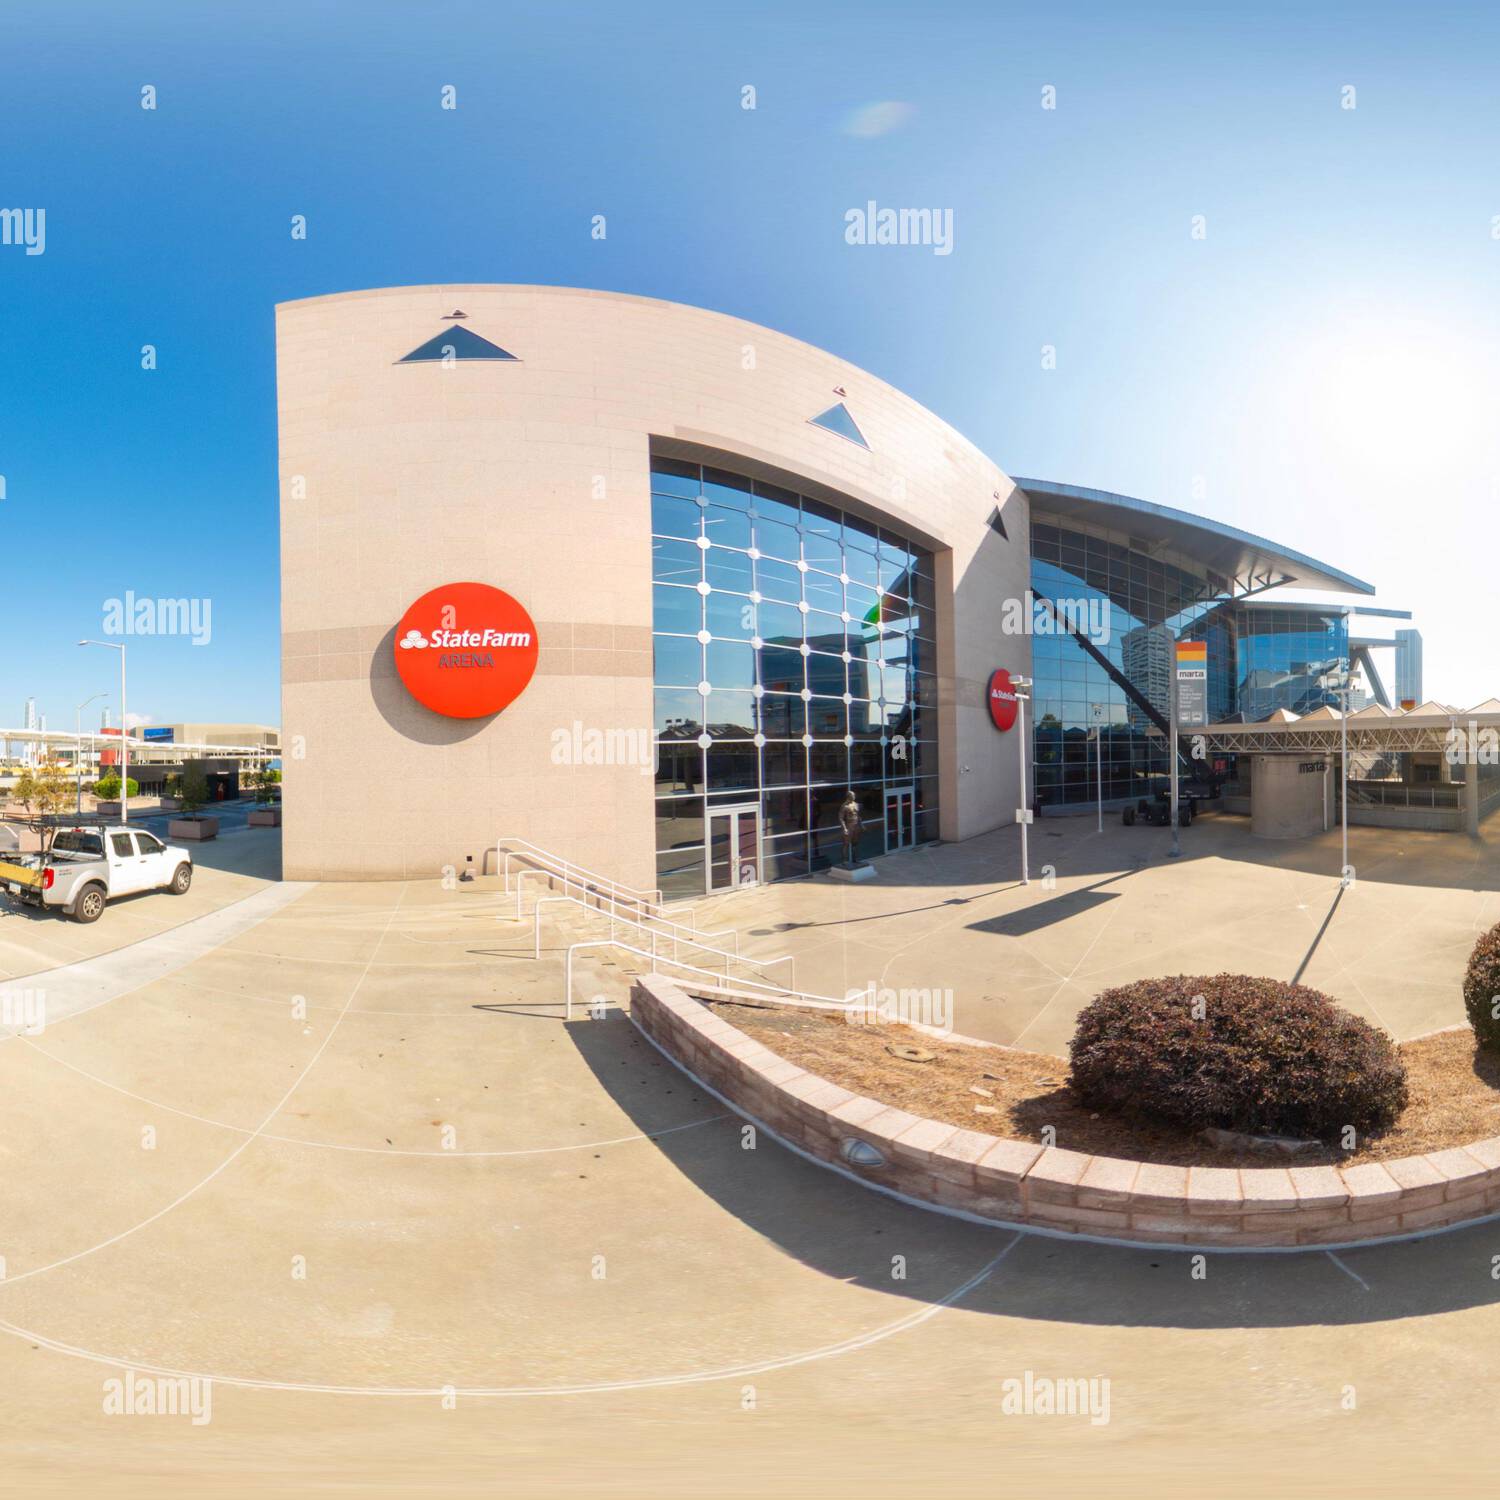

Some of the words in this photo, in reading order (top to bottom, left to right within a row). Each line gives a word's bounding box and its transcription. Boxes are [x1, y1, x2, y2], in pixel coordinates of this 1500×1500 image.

[430, 629, 481, 648] State
[482, 629, 531, 647] Farm
[439, 653, 494, 668] ARENA
[1298, 761, 1325, 774] marta
